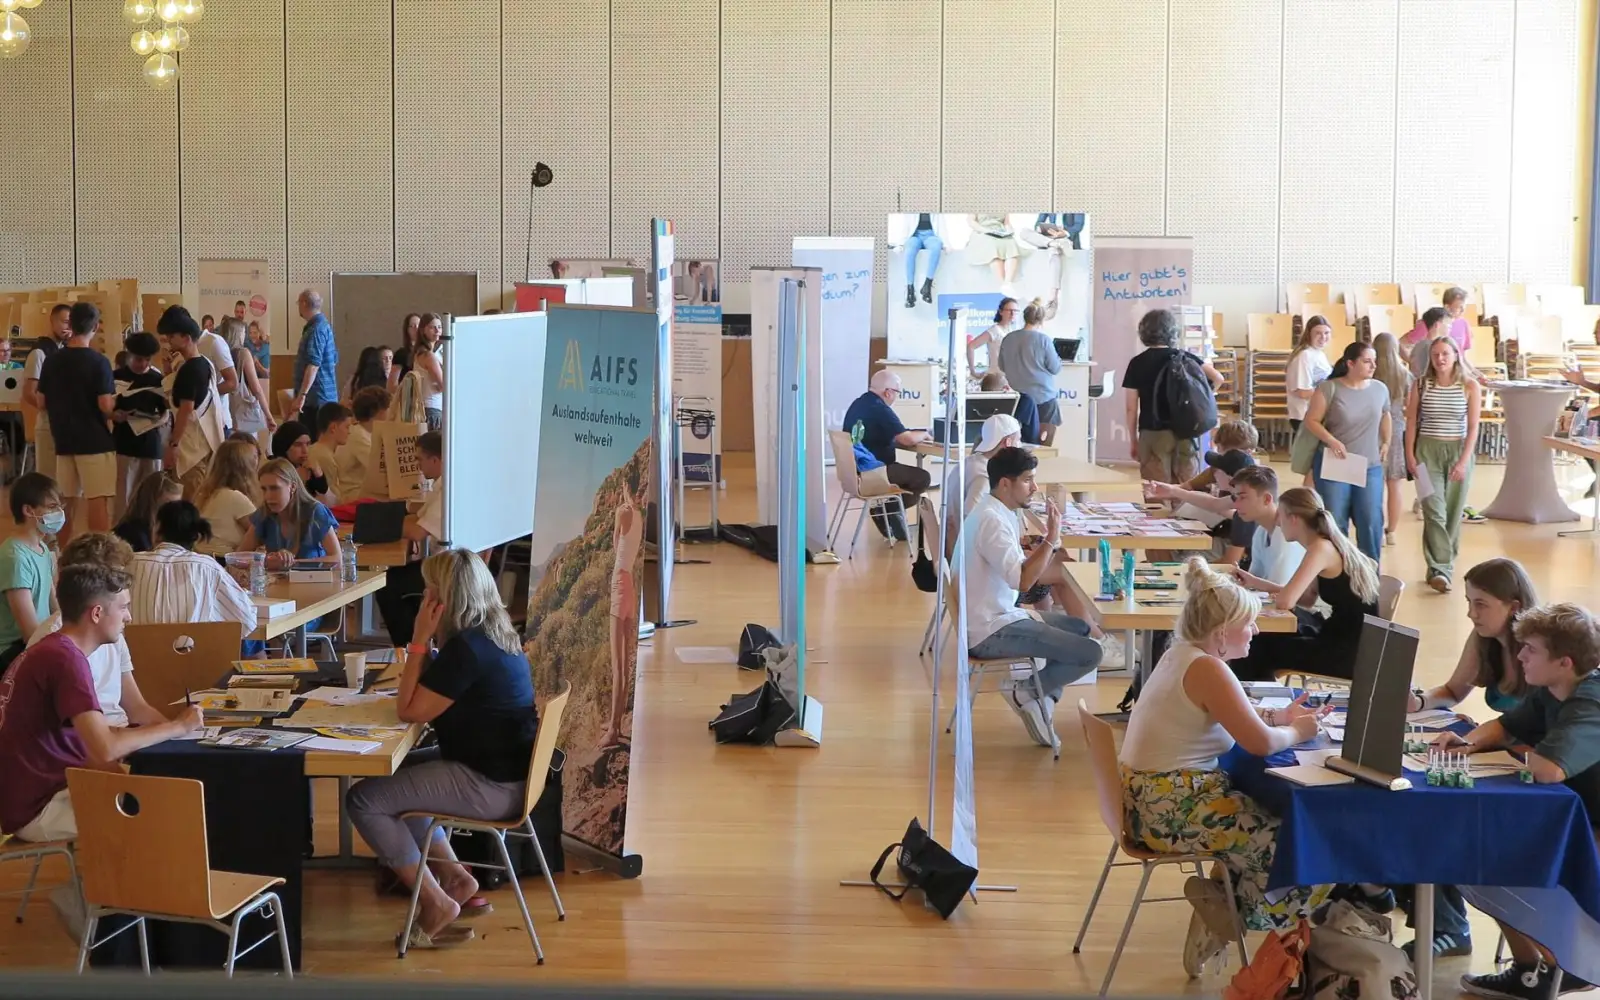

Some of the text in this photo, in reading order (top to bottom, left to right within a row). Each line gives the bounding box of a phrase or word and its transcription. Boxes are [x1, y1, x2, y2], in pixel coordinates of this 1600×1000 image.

[845, 269, 870, 280] zum
[1102, 265, 1187, 287] Hier gibt's
[1103, 282, 1189, 300] Antworten!
[590, 354, 638, 386] AIFS
[552, 403, 641, 428] Auslandsaufenthalte
[575, 429, 613, 448] weltweit
